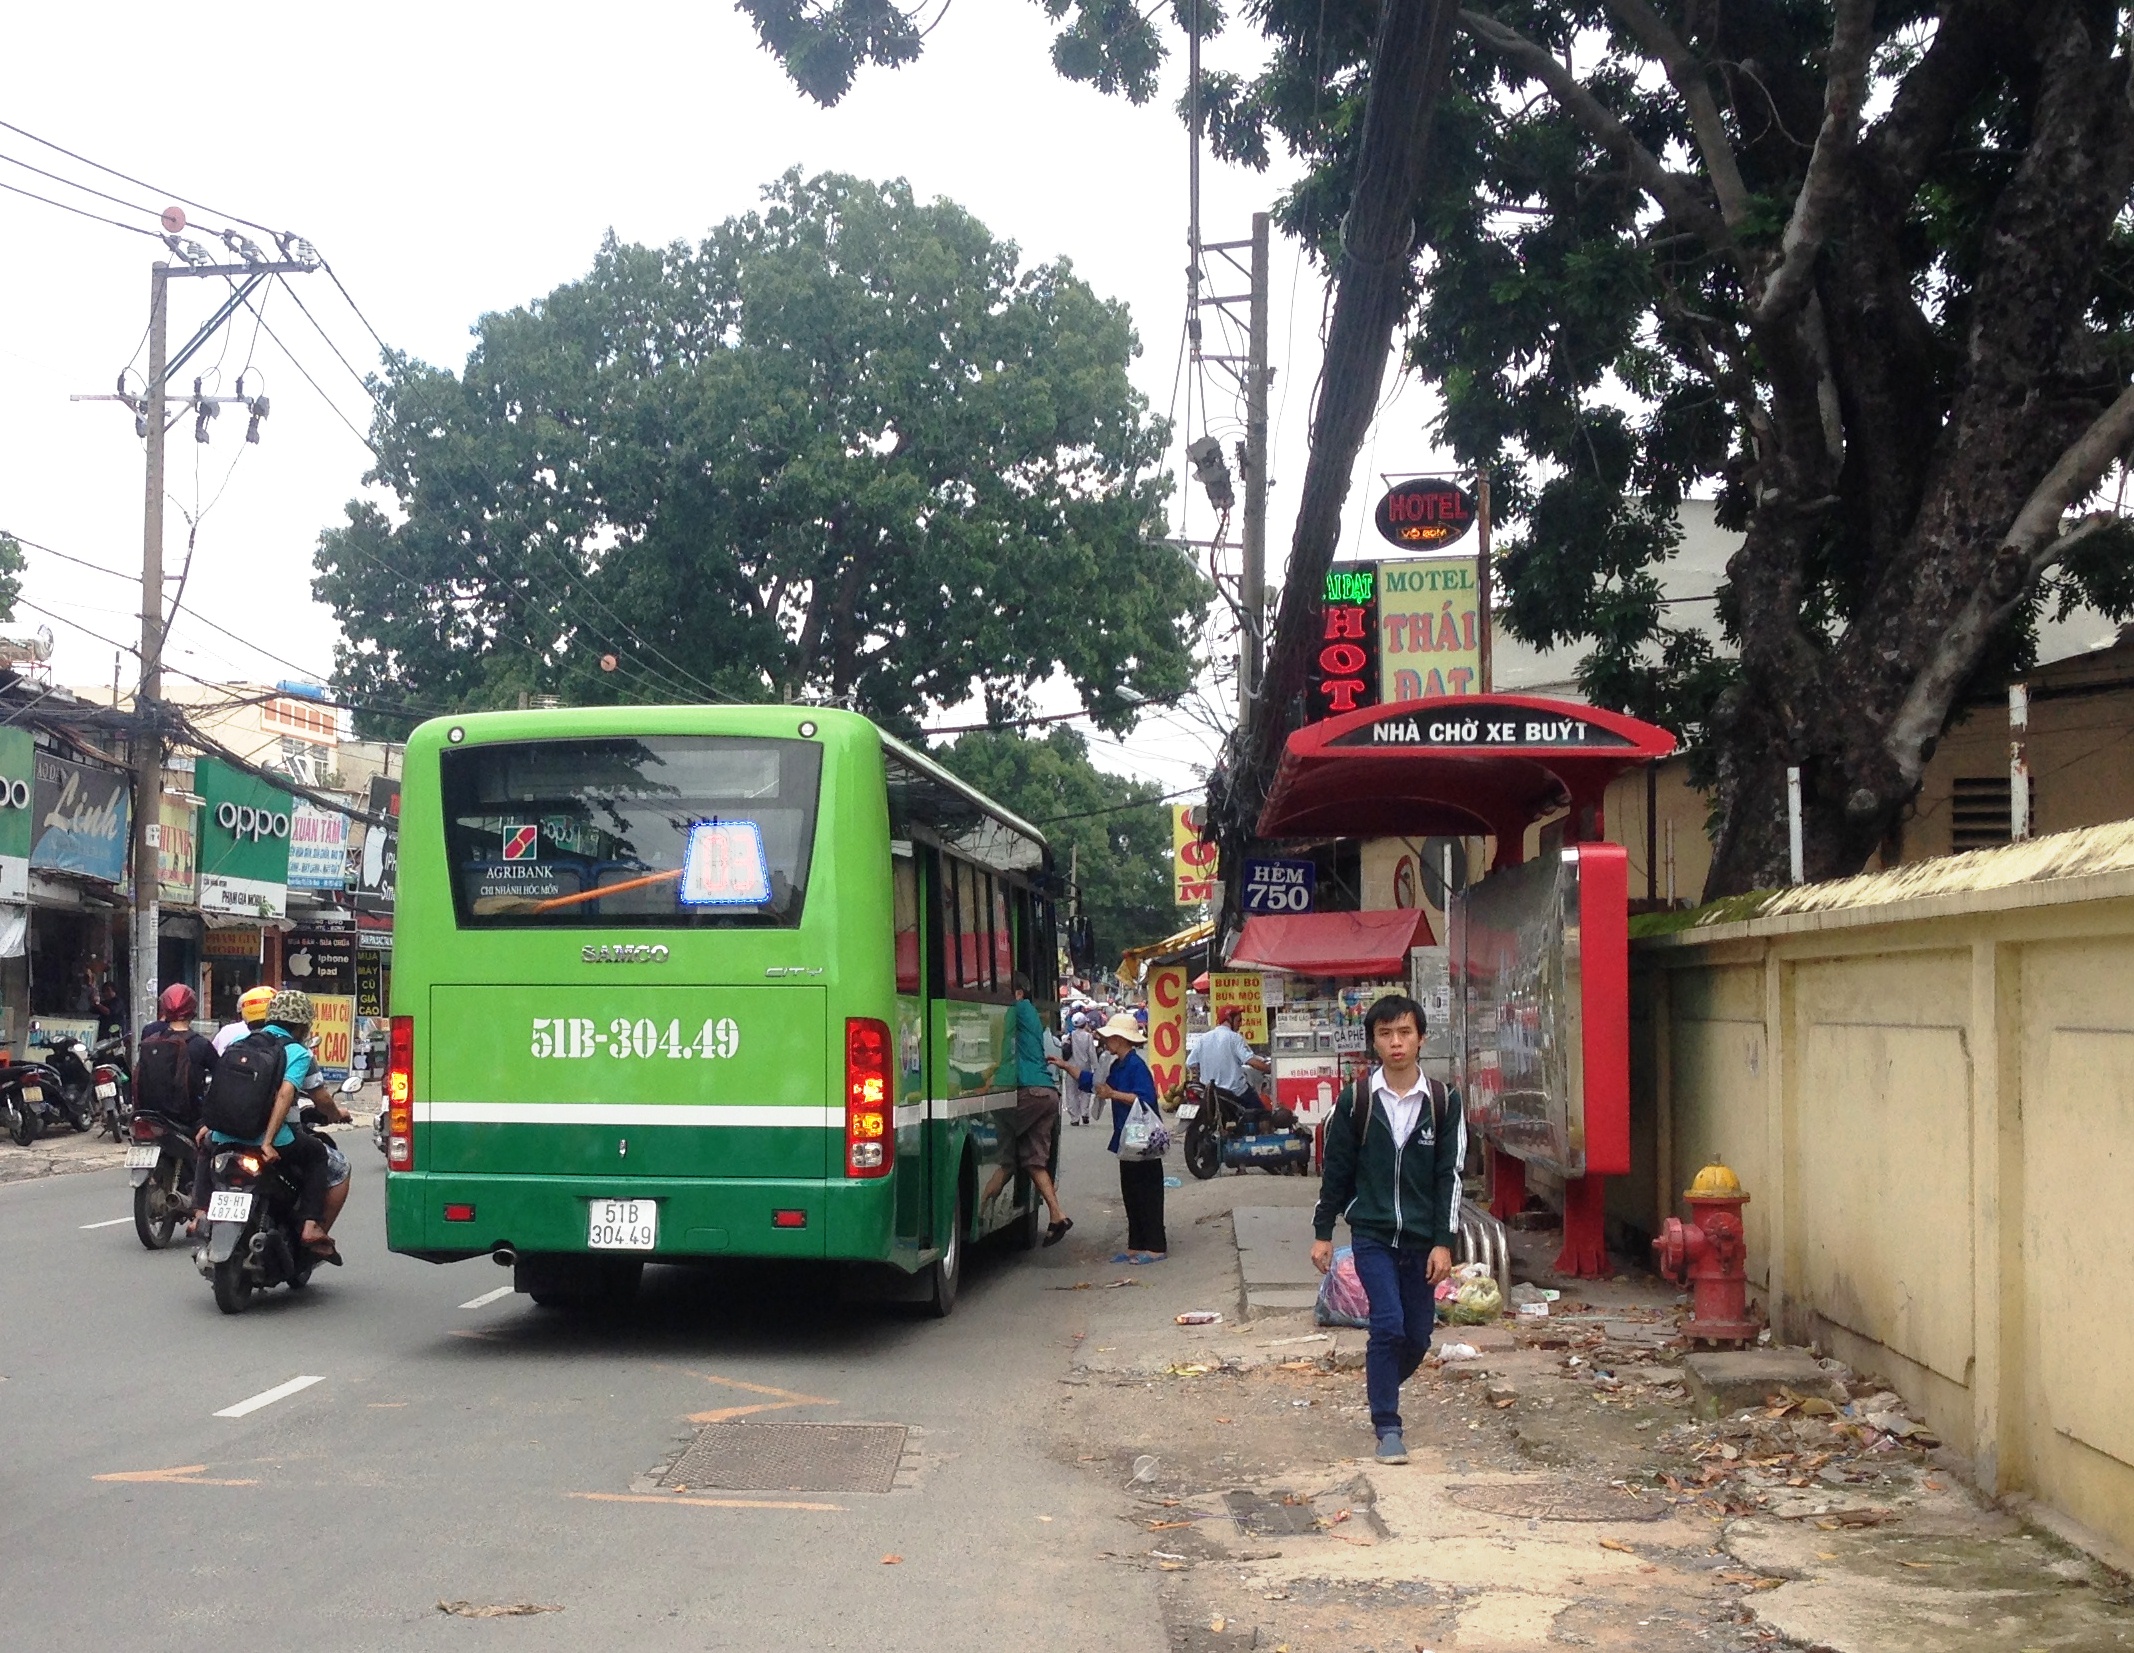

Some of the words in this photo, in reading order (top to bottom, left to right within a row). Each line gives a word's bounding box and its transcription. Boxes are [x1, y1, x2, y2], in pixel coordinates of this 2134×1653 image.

[1388, 492, 1468, 522] HOTEL
[1385, 569, 1475, 592] MOTEL
[1383, 600, 1478, 653] THÁI
[1373, 718, 1420, 742] NHÀ
[1429, 717, 1479, 742] CHỜ
[1485, 723, 1516, 742] XE
[1525, 718, 1588, 741] BUÝT
[43, 770, 122, 841] Linh
[216, 801, 289, 843] oppo
[486, 865, 554, 879] AGRIBANK
[702, 834, 756, 891] 03
[1253, 861, 1305, 884] HẺM
[480, 886, 494, 896] CHI
[495, 884, 522, 895] NHÁNH
[1247, 884, 1309, 911] 750
[318, 954, 349, 965] Iphone
[582, 944, 669, 963] SAMCO
[317, 967, 338, 976] Ipad
[765, 967, 823, 978] CITY
[358, 1006, 380, 1016] CAO
[324, 1031, 348, 1063] CAO
[530, 1017, 739, 1060] 51B-304.49
[605, 1203, 639, 1223] 51B
